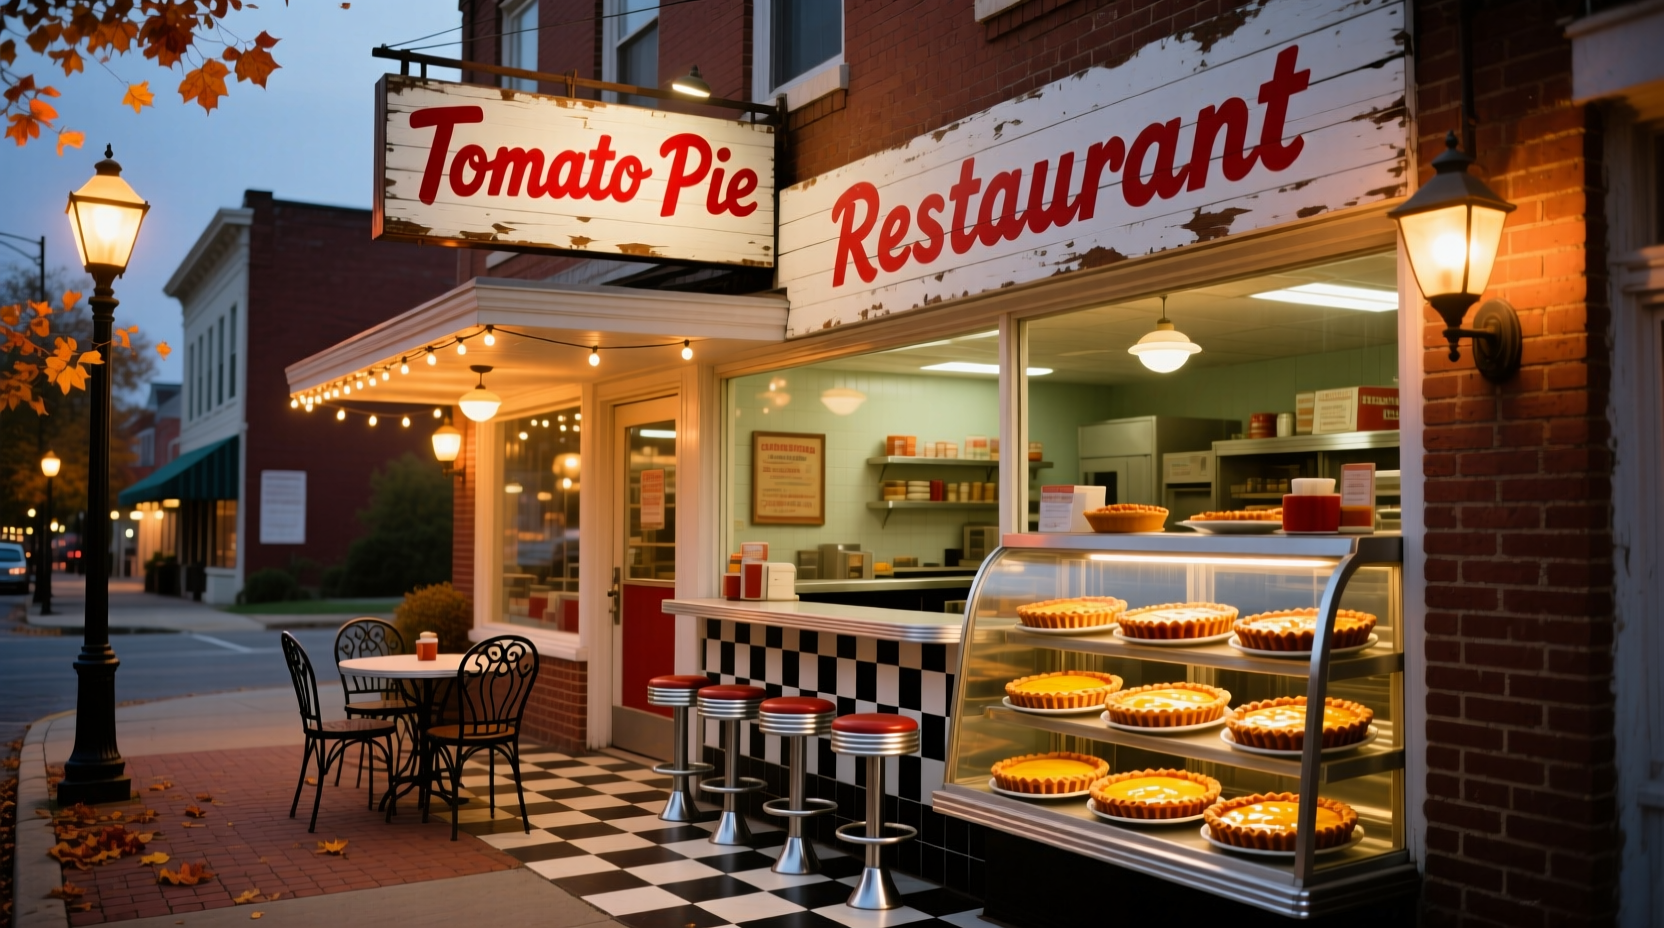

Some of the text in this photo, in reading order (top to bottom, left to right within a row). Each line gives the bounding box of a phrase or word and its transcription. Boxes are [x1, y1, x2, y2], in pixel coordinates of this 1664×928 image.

[409, 105, 759, 217] Tomato Pie
[831, 44, 1311, 288] Restaurant
